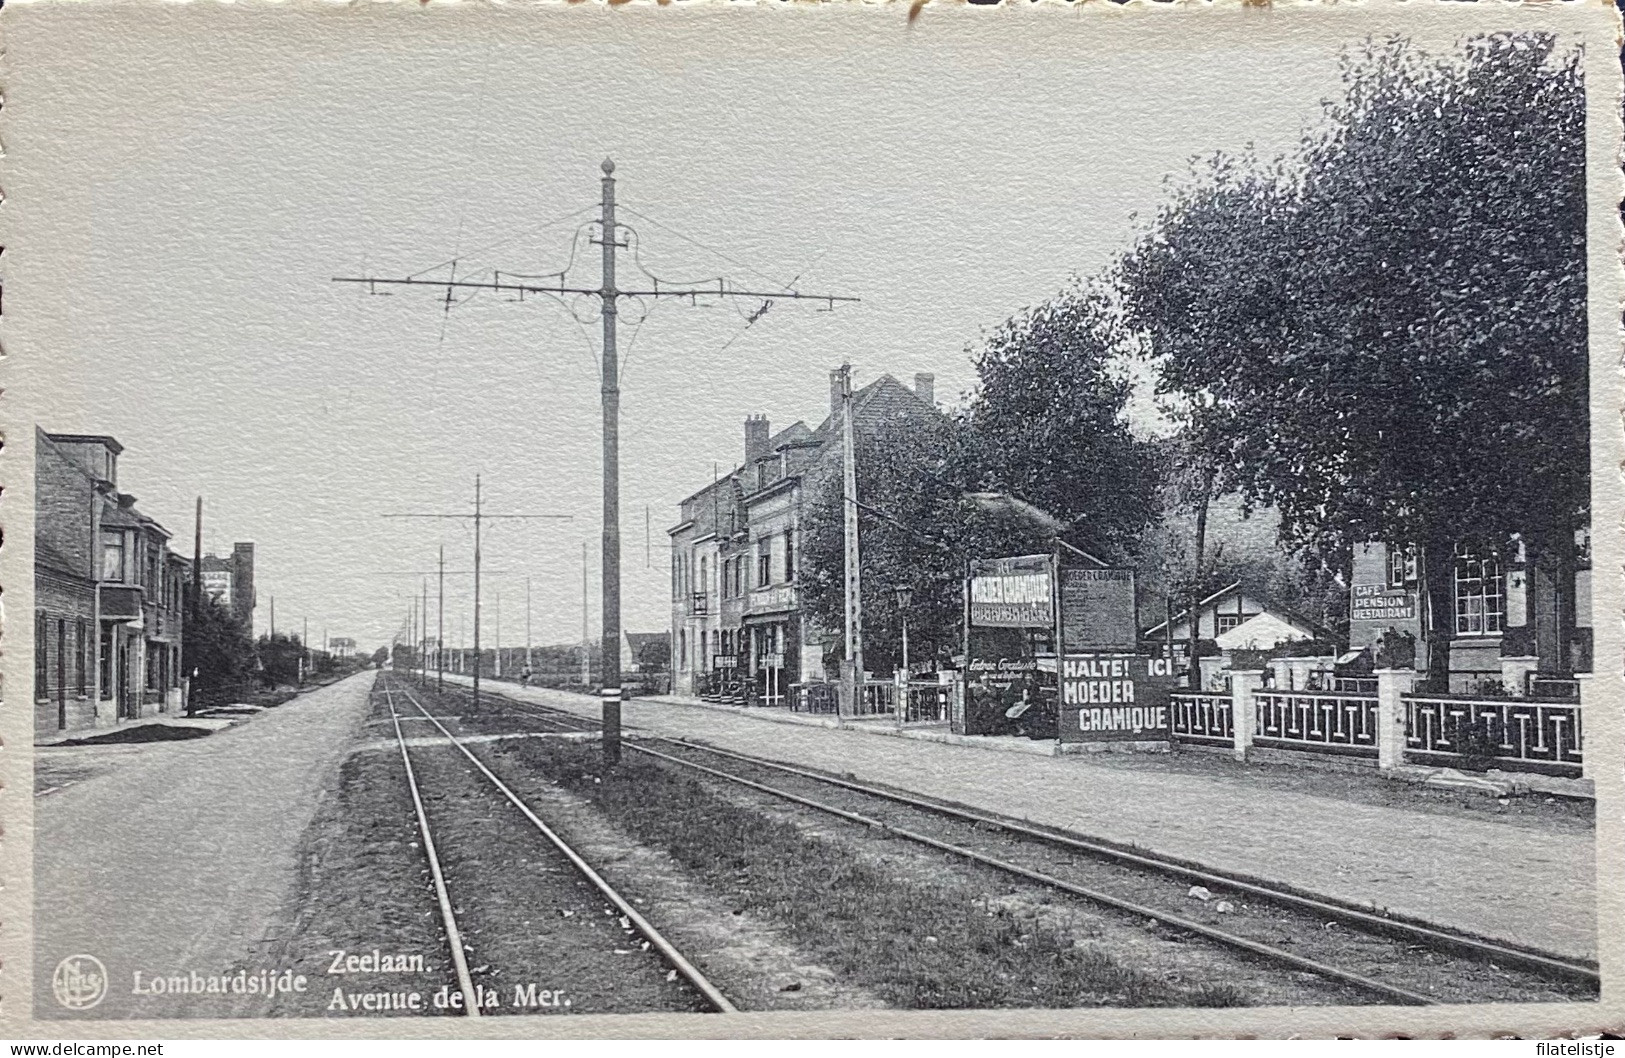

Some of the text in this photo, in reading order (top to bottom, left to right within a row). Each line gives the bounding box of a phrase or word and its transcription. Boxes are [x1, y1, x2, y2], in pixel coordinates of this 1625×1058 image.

[1353, 607, 1412, 619] RESTAURANT
[1355, 597, 1404, 608] PENSION
[1063, 658, 1173, 678] HALTE! ICI
[1063, 680, 1135, 704] MOEDER
[1078, 706, 1168, 734] CRAMIQUE
[327, 949, 433, 975] Zeelaan.
[131, 968, 308, 999] Lombardsijde
[433, 984, 464, 1009] de
[475, 983, 501, 1008] la
[513, 983, 572, 1007] Mer.
